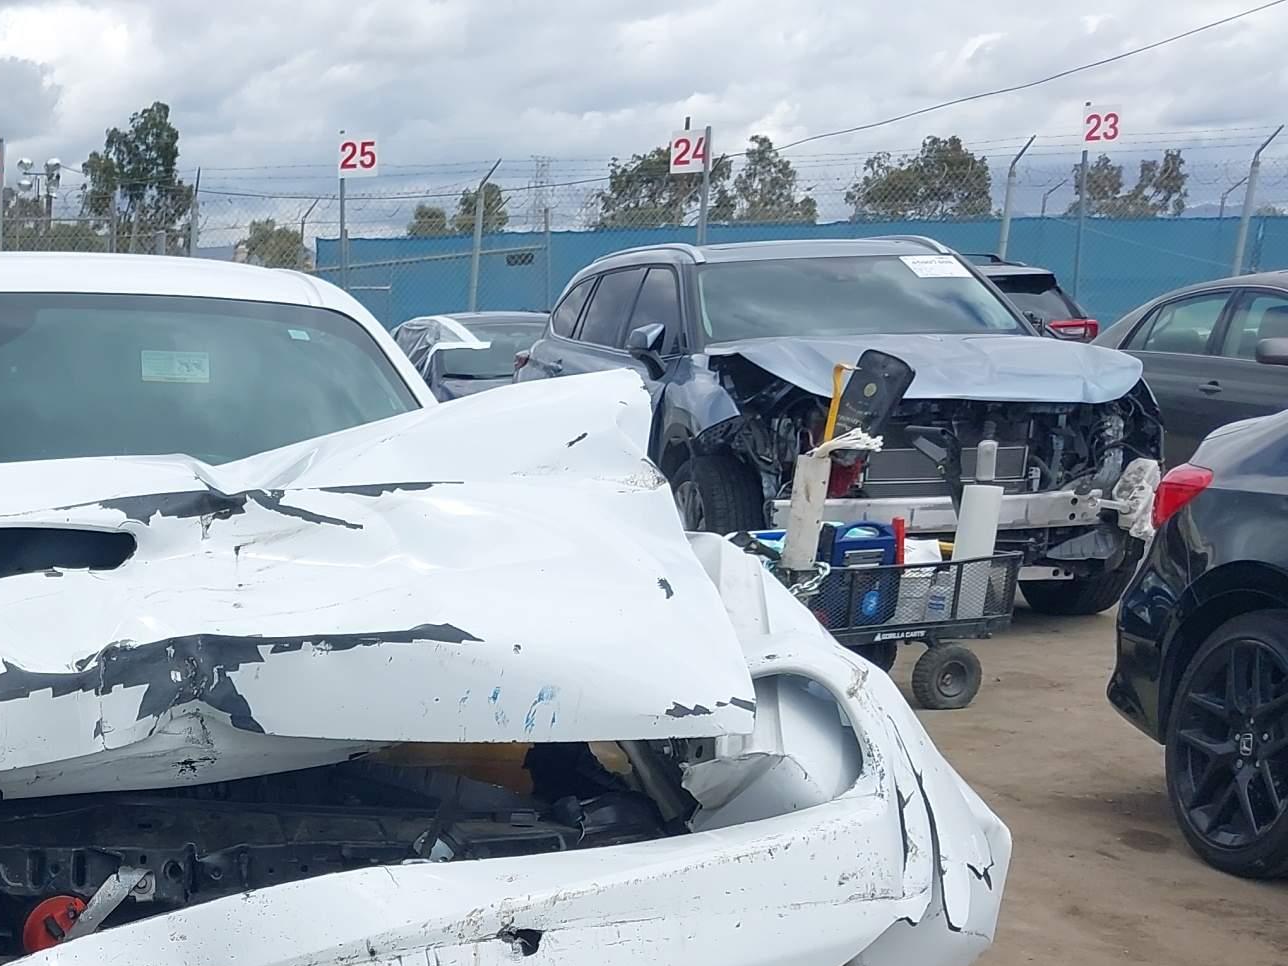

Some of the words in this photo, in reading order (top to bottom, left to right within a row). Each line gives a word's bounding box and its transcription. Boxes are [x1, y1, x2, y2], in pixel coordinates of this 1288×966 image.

[1085, 112, 1119, 141] 23
[340, 141, 376, 169] 25
[673, 136, 705, 166] 24
